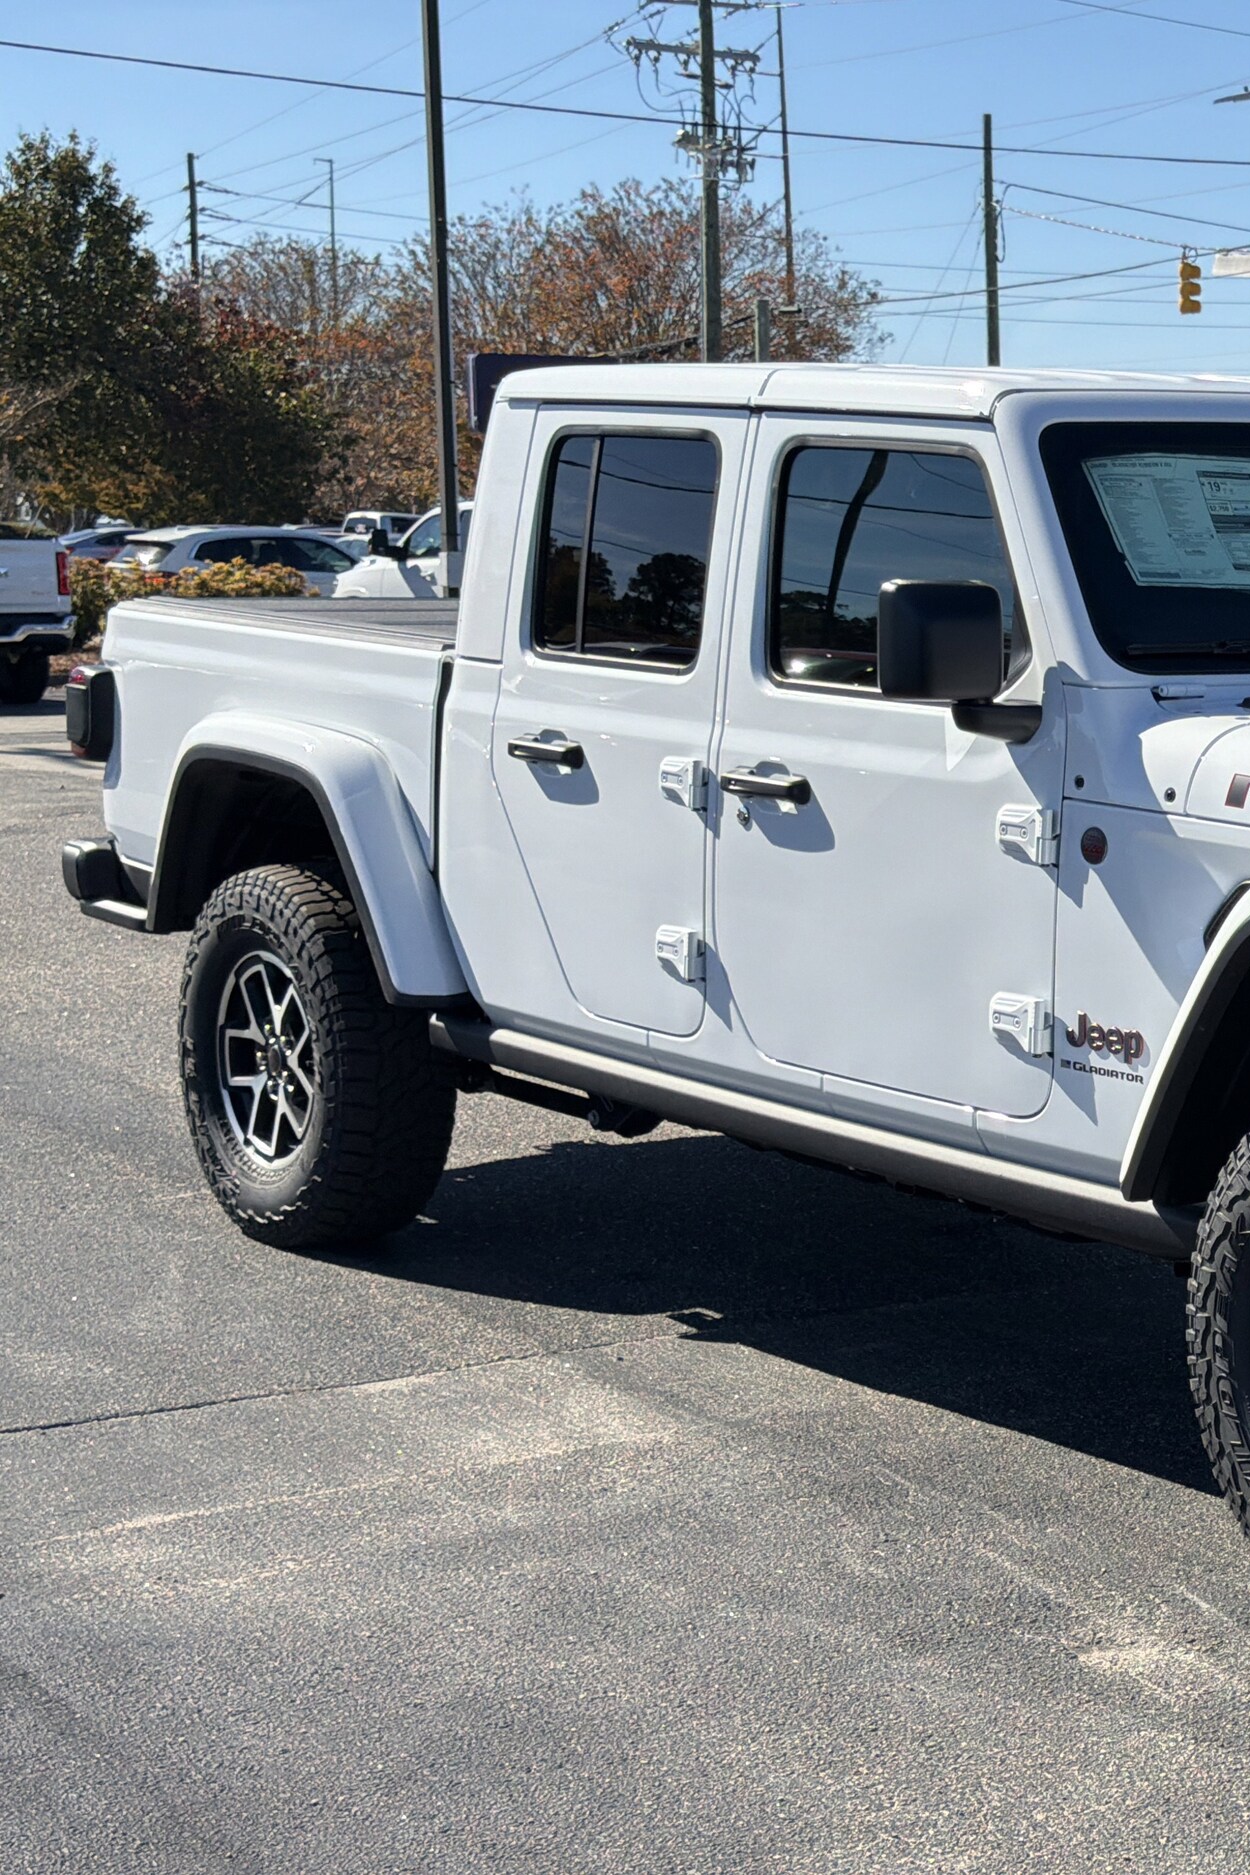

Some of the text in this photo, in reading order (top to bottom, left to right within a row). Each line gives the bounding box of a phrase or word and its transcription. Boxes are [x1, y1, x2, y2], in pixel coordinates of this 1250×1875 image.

[1207, 481, 1221, 492] 19
[1066, 1010, 1144, 1064] Jeep
[1072, 1061, 1144, 1085] GLADIATOR
